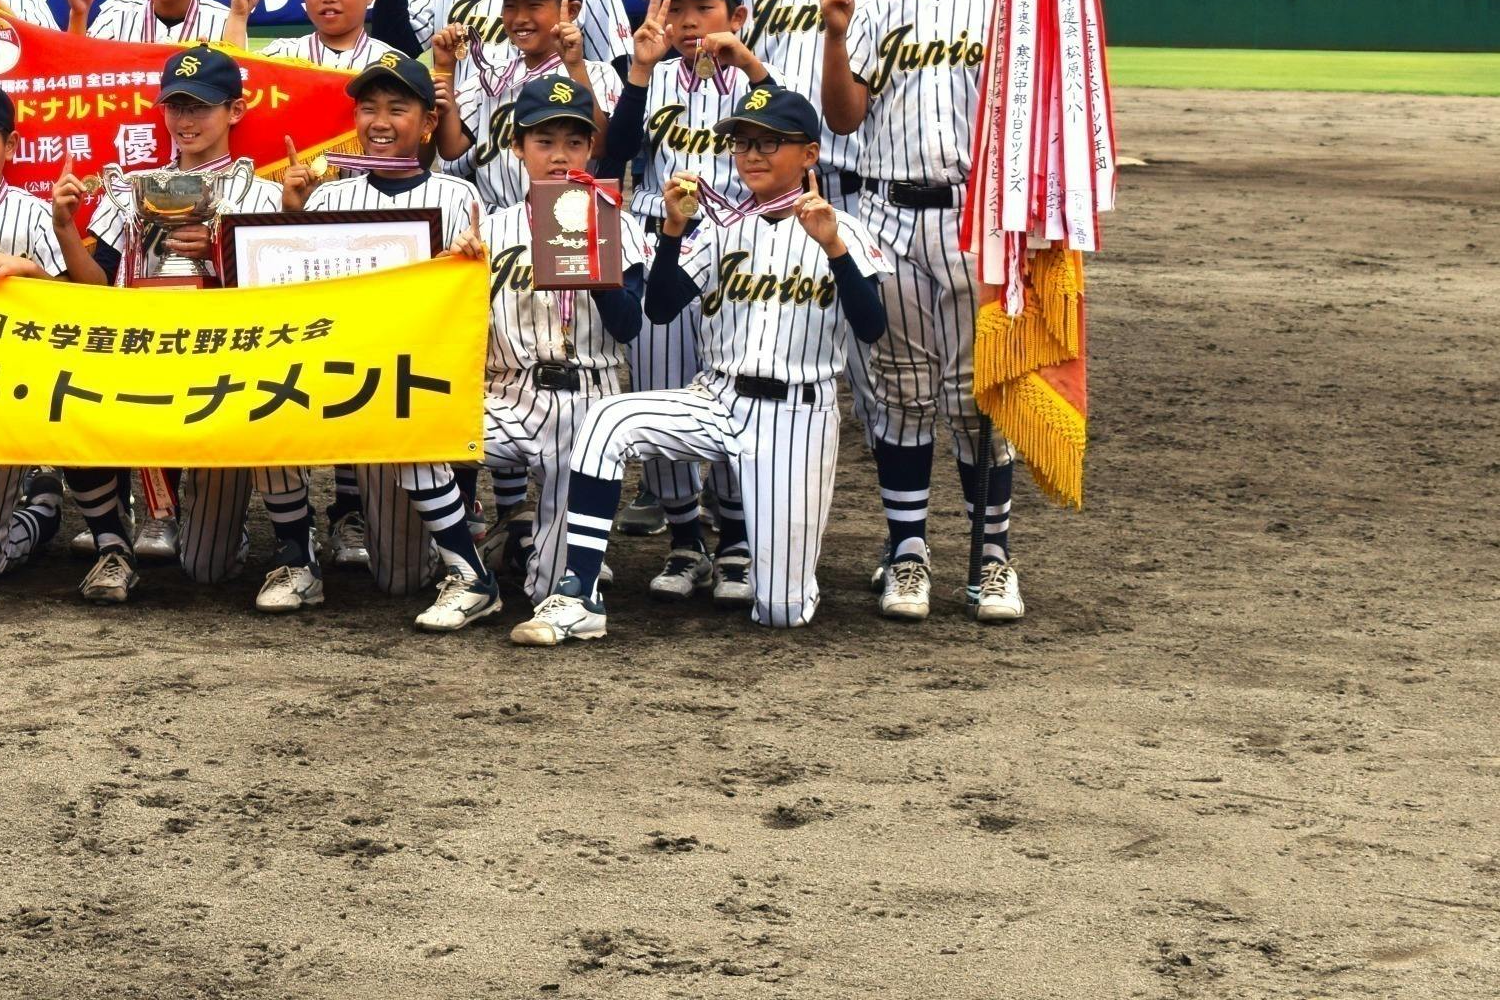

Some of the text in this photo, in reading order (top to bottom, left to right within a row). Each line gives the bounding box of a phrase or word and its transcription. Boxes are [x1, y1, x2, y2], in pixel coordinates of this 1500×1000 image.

[869, 23, 984, 96] Junio
[12, 134, 92, 165] 山形県
[702, 250, 835, 317] Junior
